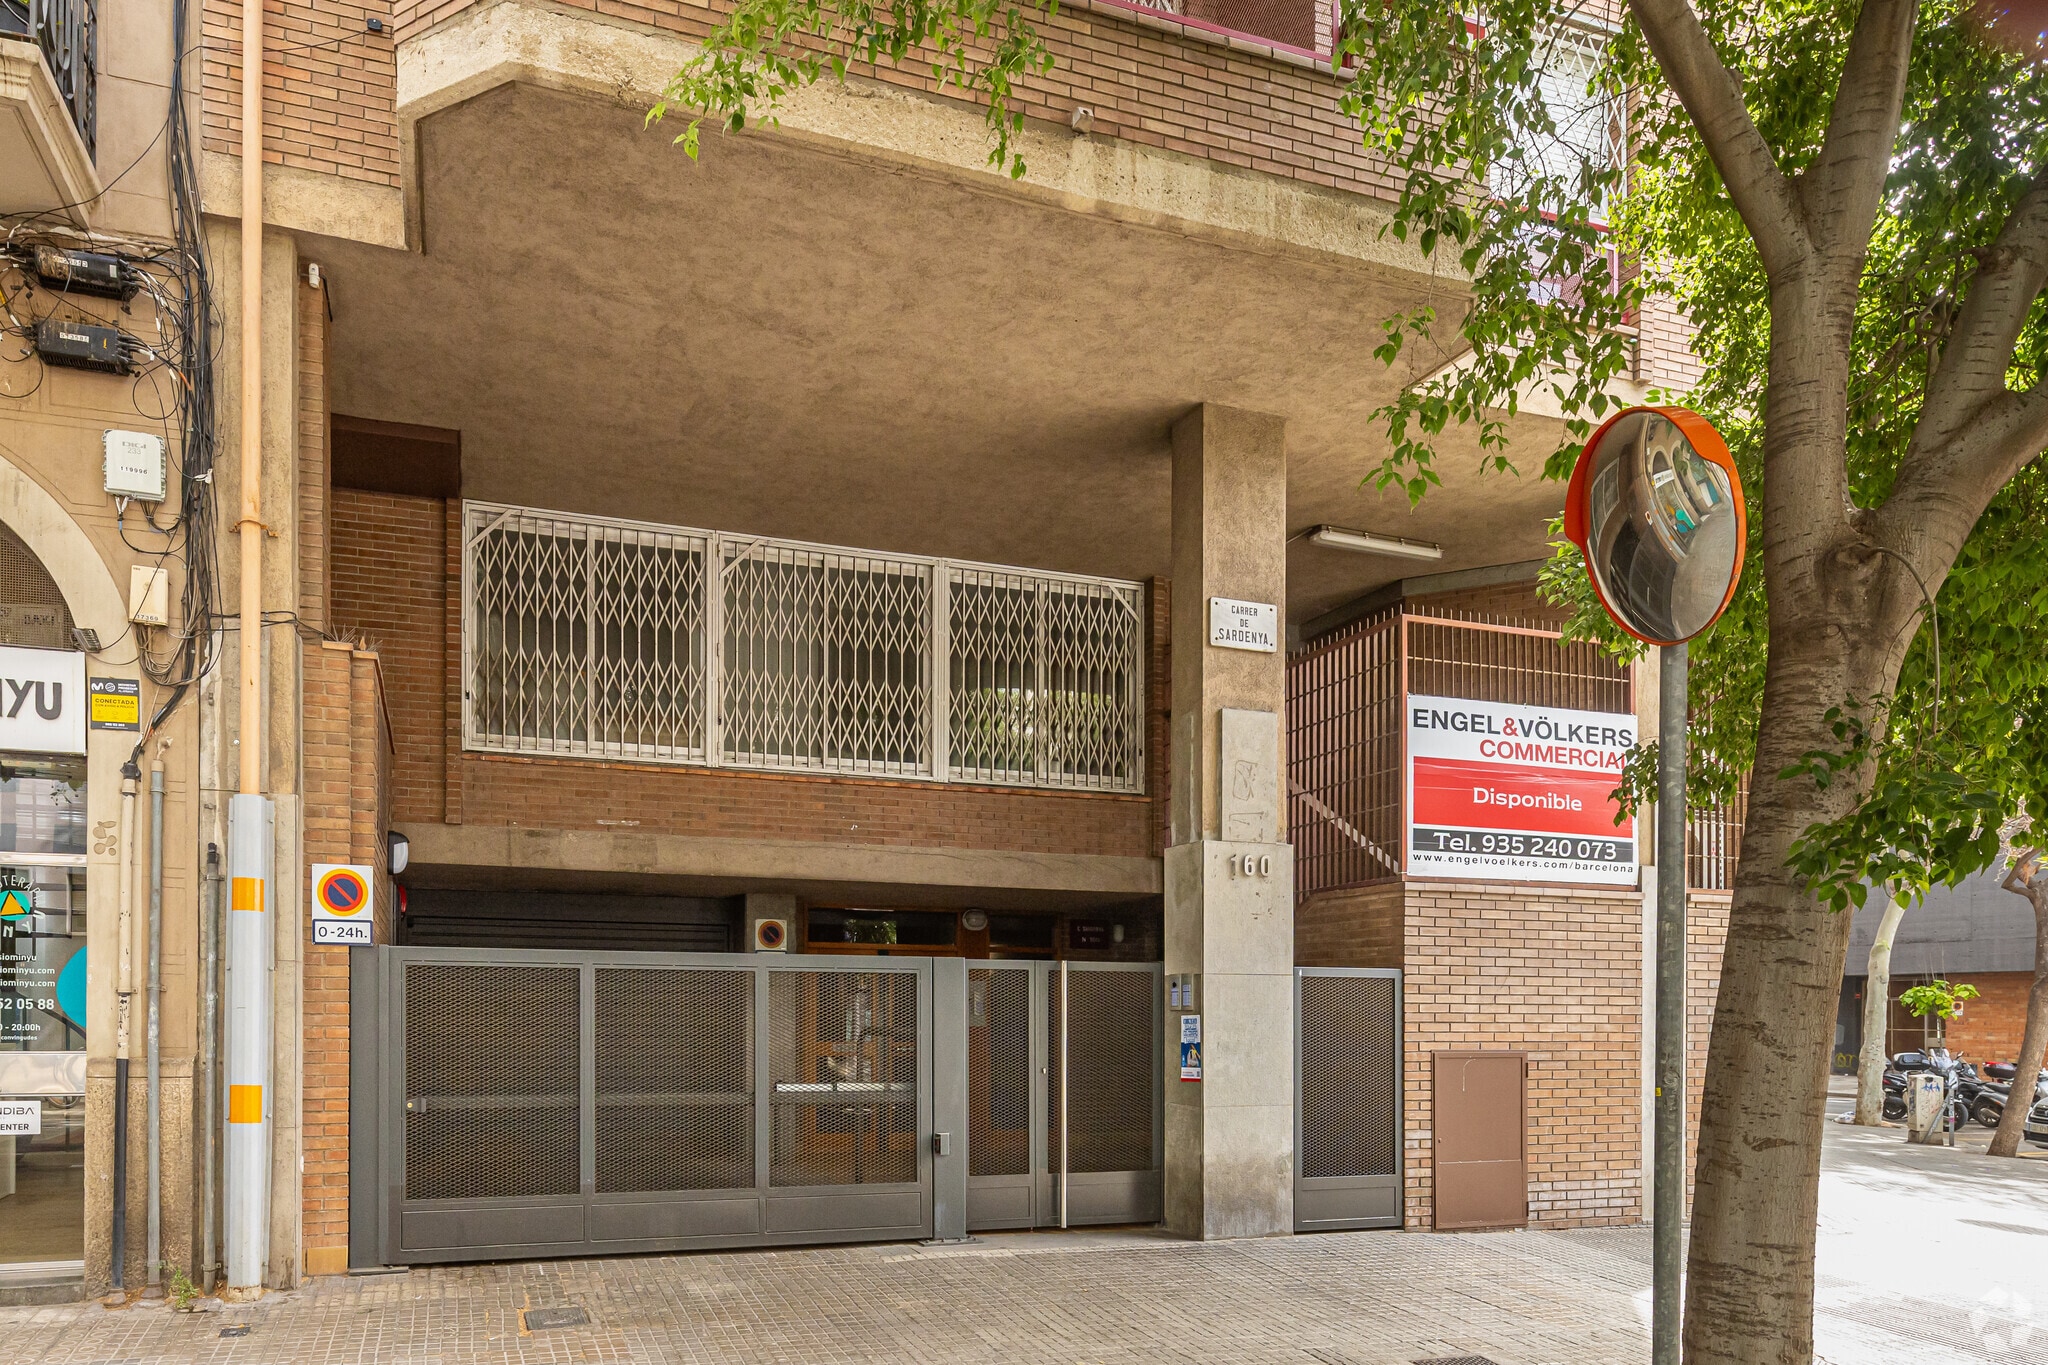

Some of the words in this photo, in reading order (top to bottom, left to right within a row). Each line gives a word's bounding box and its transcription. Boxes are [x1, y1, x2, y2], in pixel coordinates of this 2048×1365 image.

[1231, 605, 1258, 617] CARRER
[1239, 618, 1249, 628] DE
[1218, 627, 1269, 645] SARDENYA
[0, 679, 62, 720] YU
[1413, 708, 1633, 748] ENGEL&VÖLKERS
[1473, 787, 1583, 812] Disponible
[1432, 831, 1477, 852] Tel.
[1481, 834, 1525, 854] 935
[1529, 837, 1572, 858] 240
[1577, 840, 1617, 861] 073
[1228, 853, 1271, 878] 160
[1412, 853, 1634, 873] www.engelvoelkers.com/barcelona
[16, 998, 34, 1010] 05
[37, 998, 55, 1010] 88
[11, 1023, 41, 1032] 20:00h
